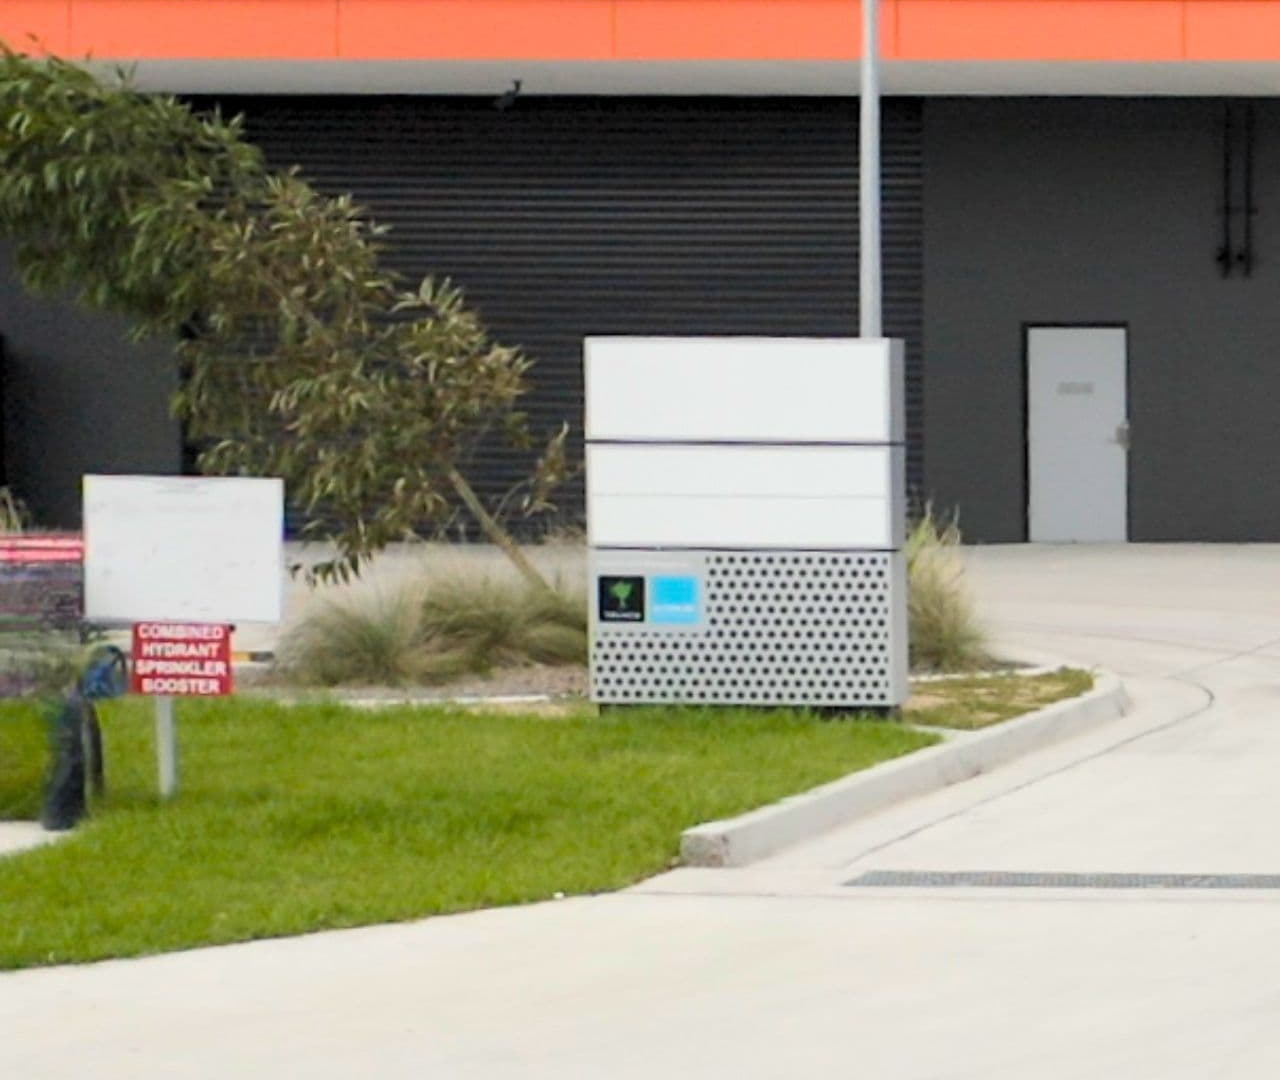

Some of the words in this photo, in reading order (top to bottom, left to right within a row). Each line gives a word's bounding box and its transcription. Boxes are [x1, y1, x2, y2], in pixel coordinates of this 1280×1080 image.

[139, 624, 224, 639] COMBINED
[142, 642, 220, 657] HYDRANT
[135, 660, 227, 675] SPRINKLER
[141, 678, 220, 693] BOOSTER
